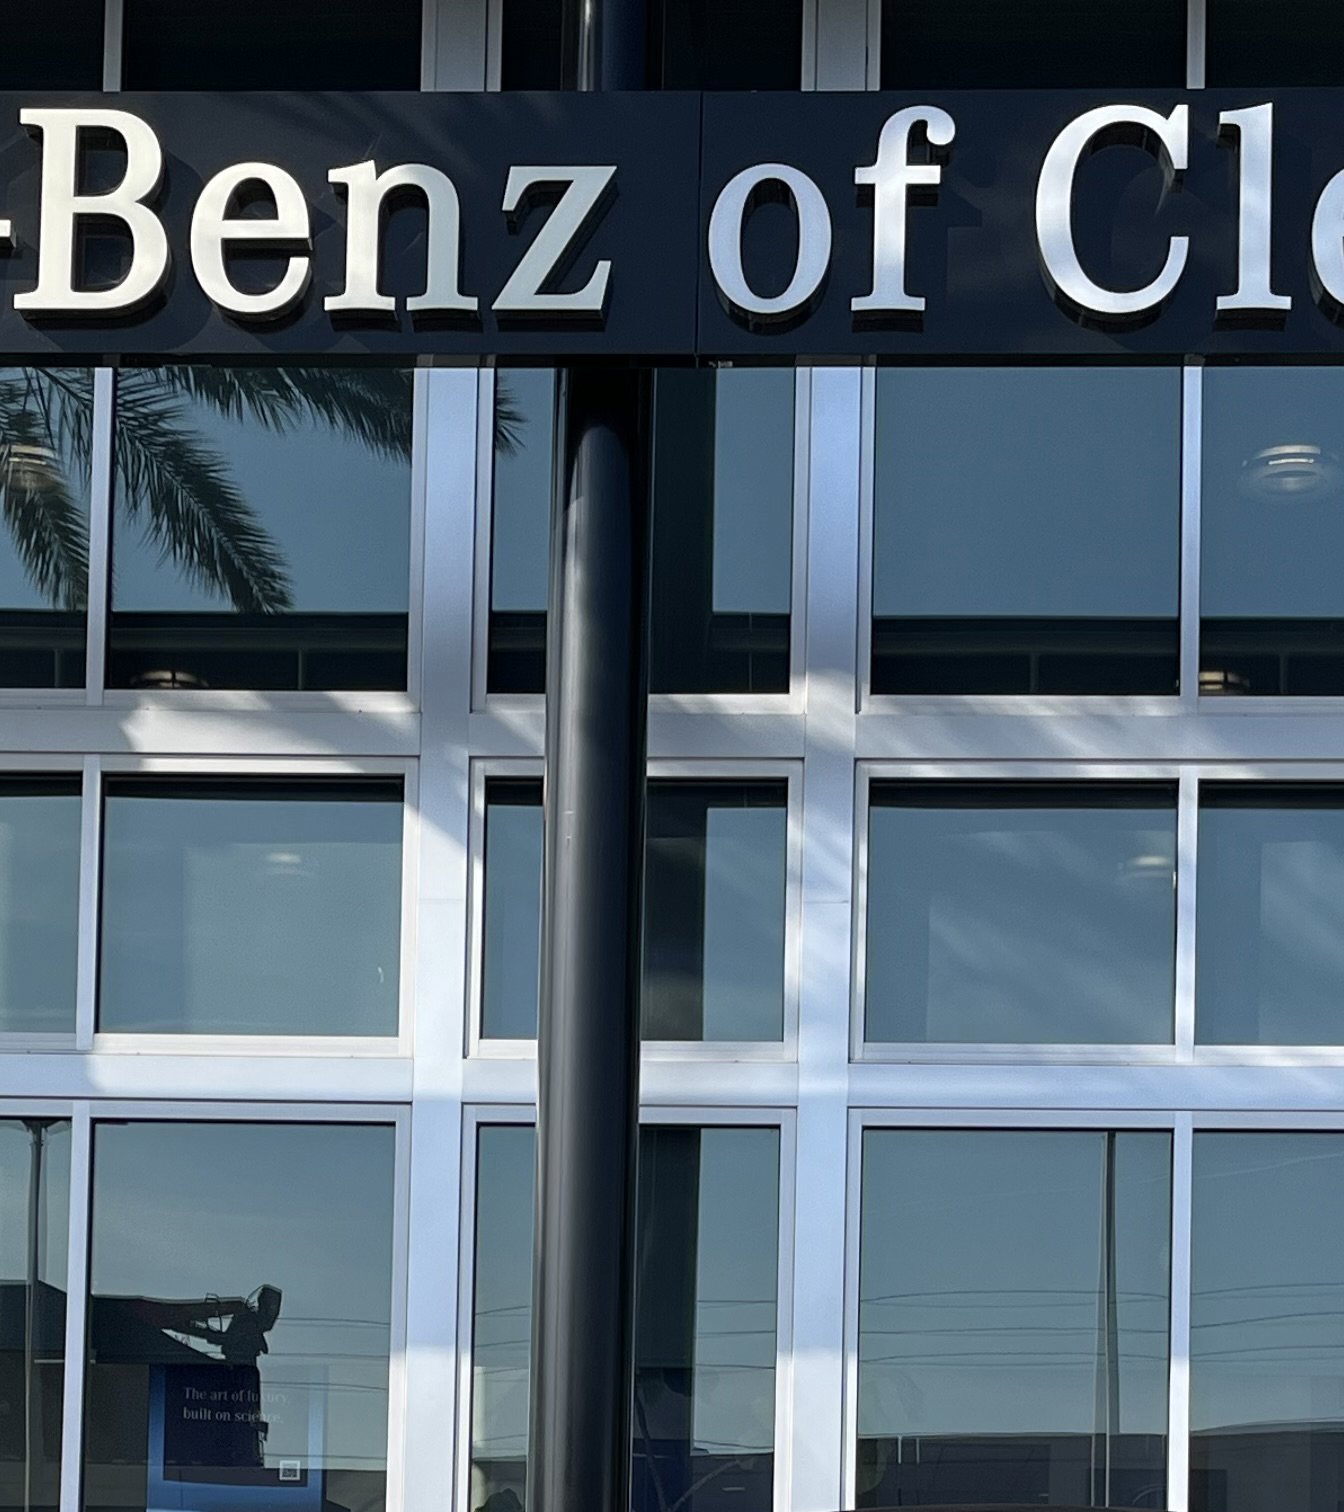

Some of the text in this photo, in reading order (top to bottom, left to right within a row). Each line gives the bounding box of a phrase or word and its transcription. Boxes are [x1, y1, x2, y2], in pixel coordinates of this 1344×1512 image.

[709, 105, 956, 314] of
[183, 1387, 208, 1401] The
[210, 1390, 228, 1401] art
[231, 1389, 245, 1402] of
[183, 1406, 212, 1421] built
[215, 1410, 231, 1422] on
